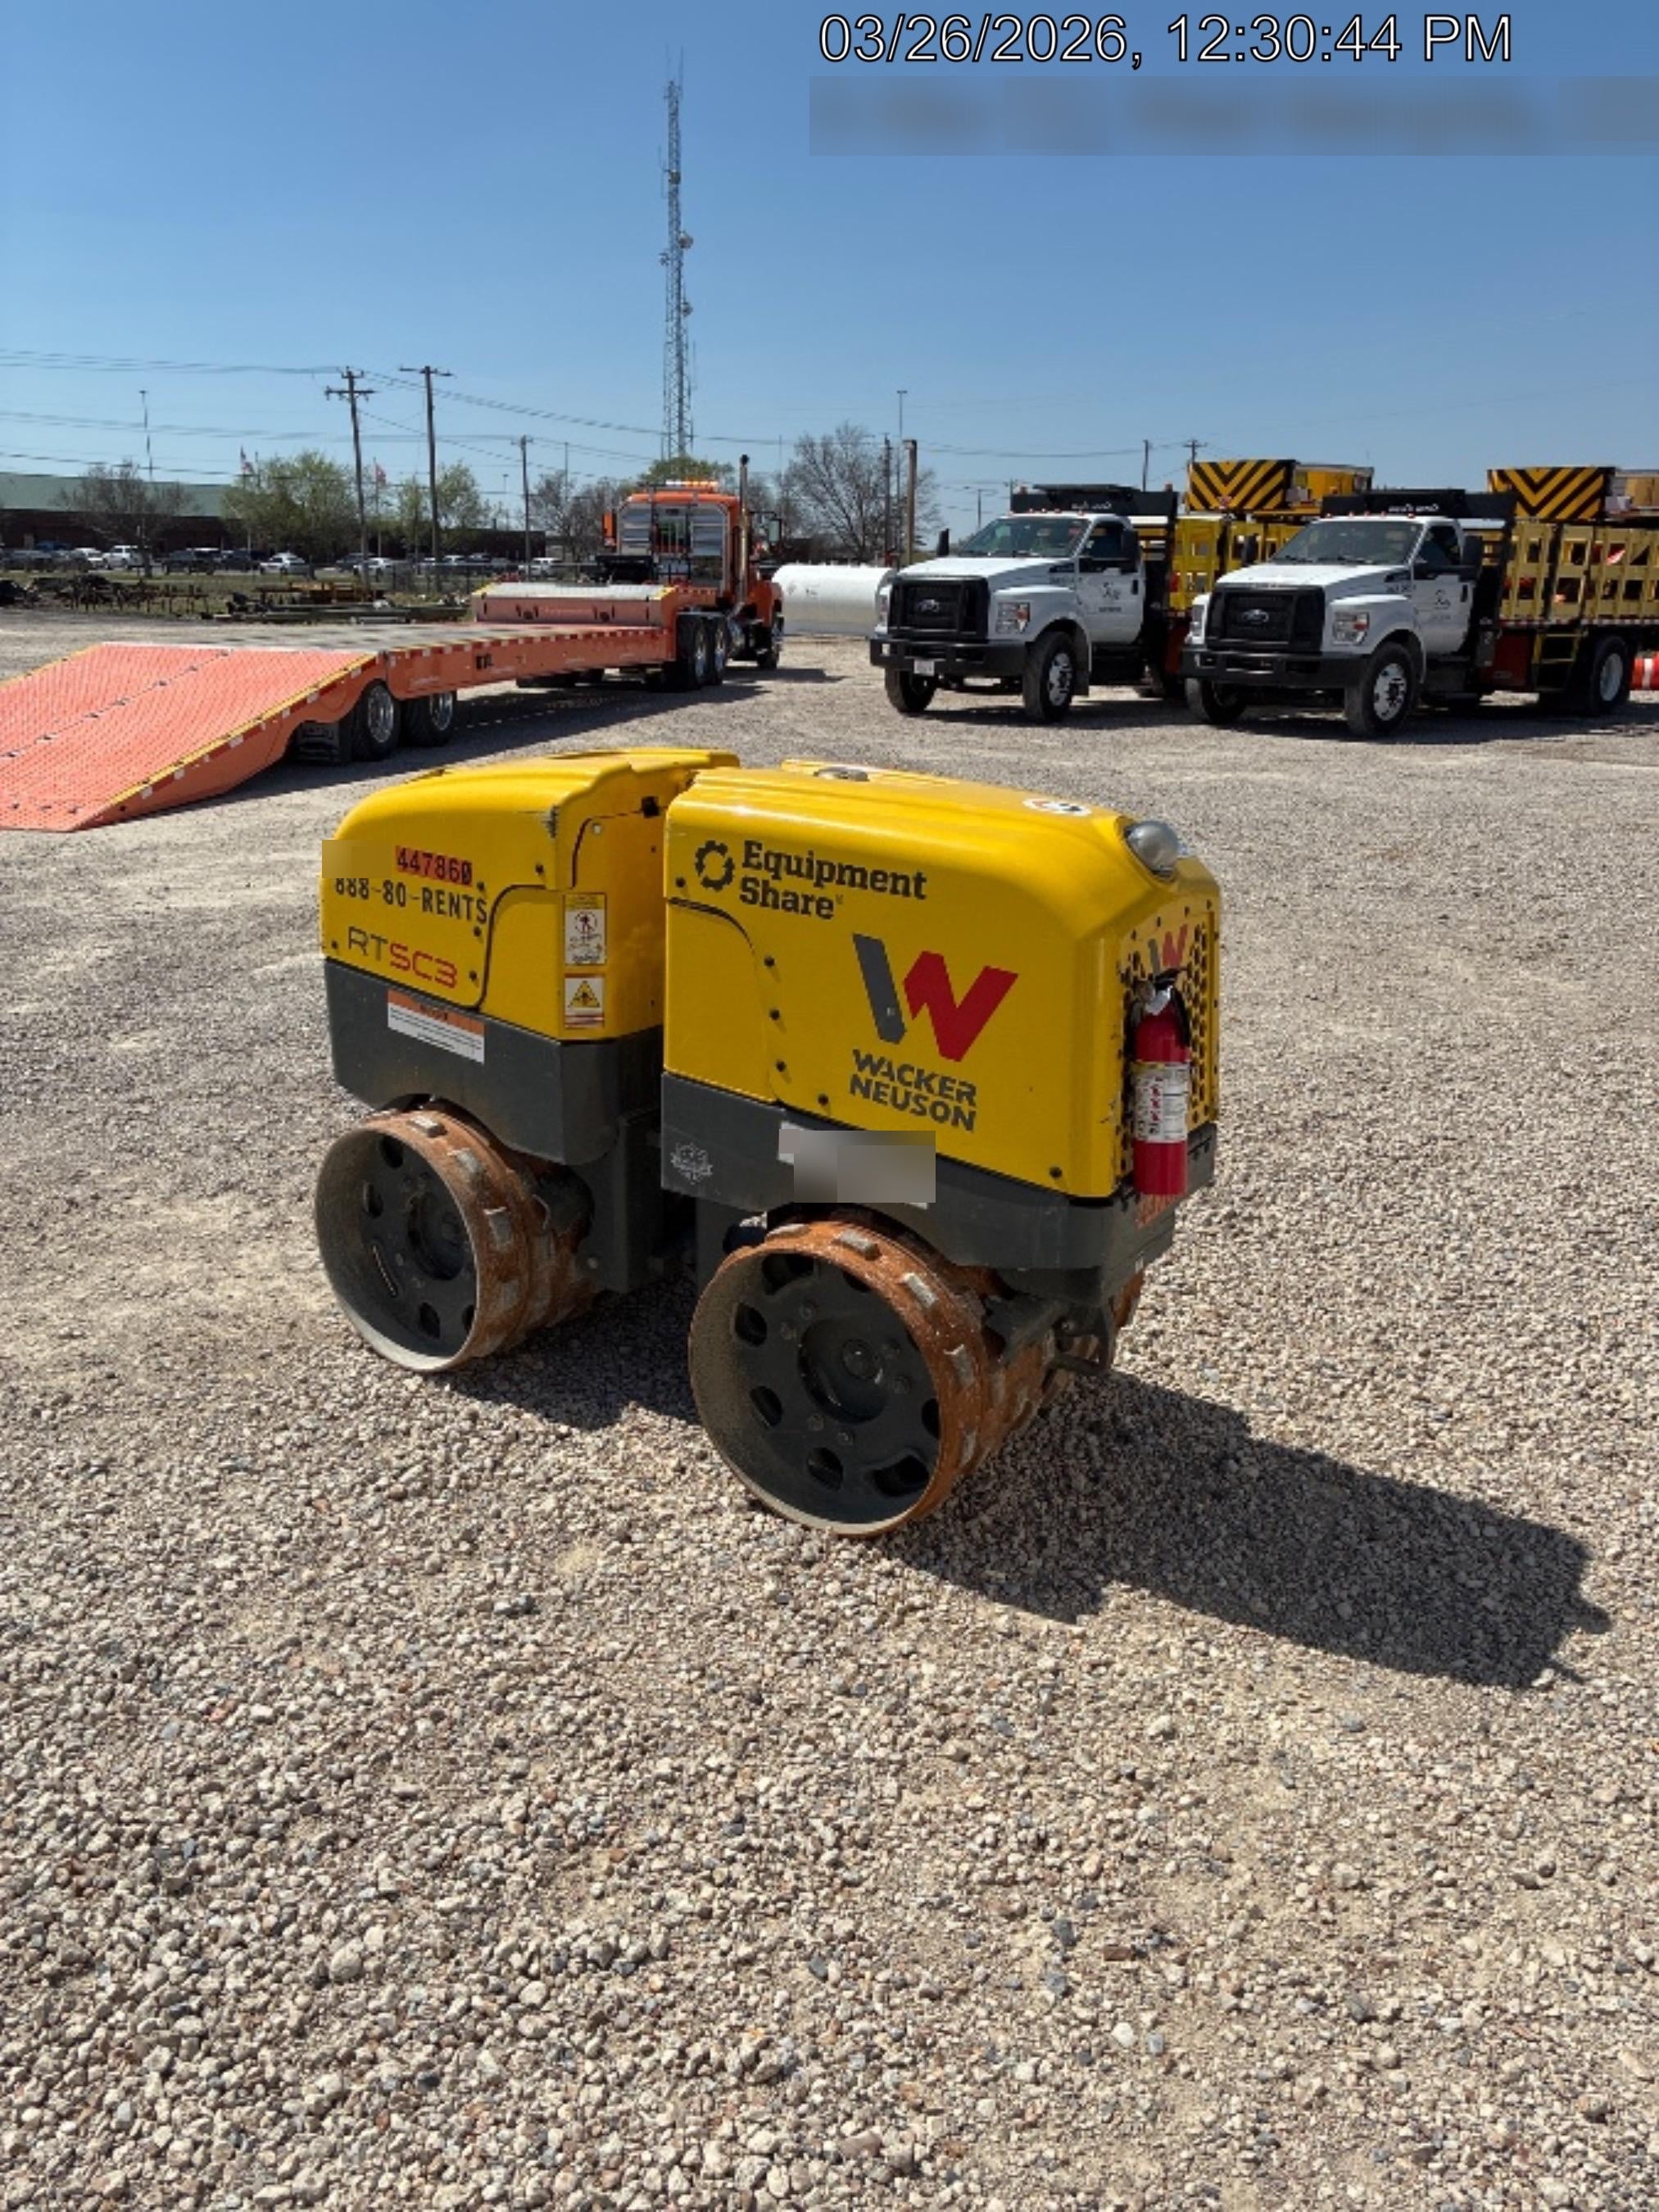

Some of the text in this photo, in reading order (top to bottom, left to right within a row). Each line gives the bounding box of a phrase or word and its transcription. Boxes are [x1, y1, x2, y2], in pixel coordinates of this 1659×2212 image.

[397, 847, 474, 886] 447860
[742, 840, 927, 900] Equipment
[347, 925, 459, 989] RTSC3
[850, 1073, 977, 1132] NEUSON
[853, 1049, 977, 1107] WACKER
